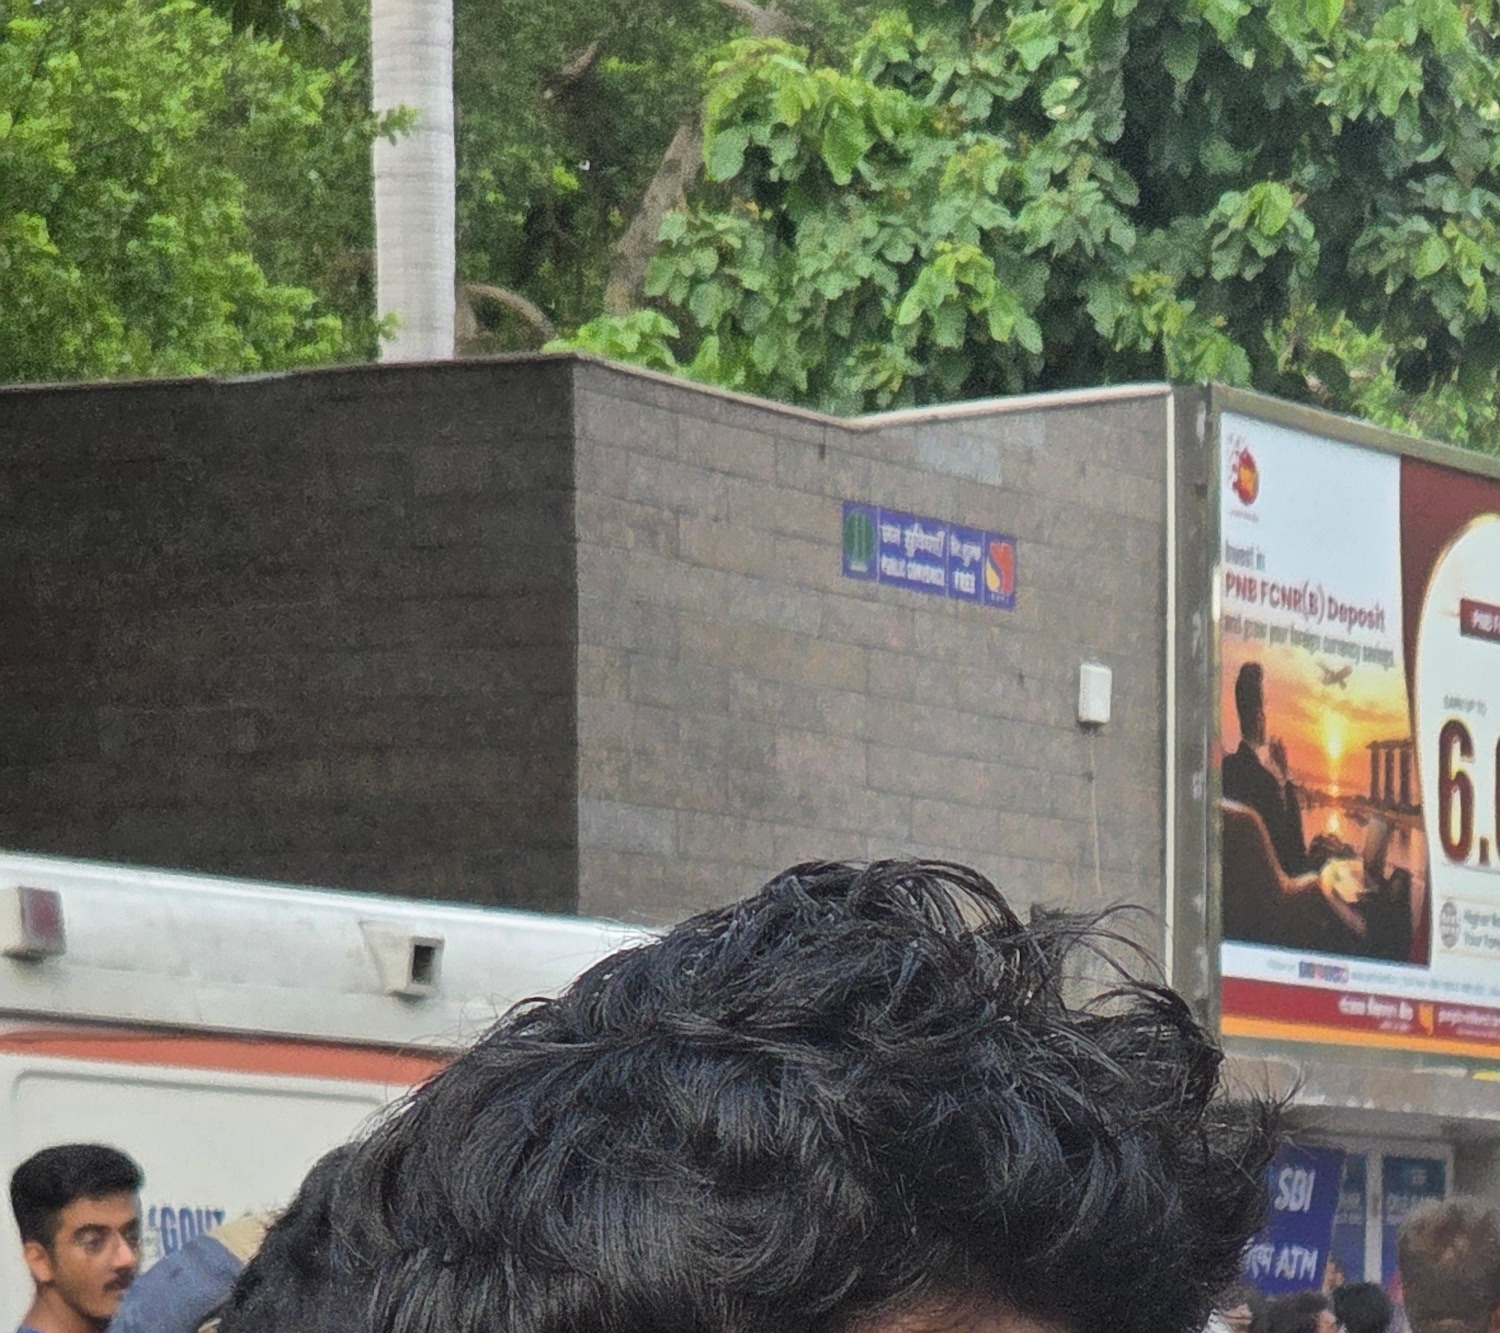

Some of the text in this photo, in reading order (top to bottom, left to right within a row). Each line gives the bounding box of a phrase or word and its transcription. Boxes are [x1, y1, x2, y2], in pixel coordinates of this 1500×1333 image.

[1225, 570, 1258, 604] PNB
[1327, 592, 1386, 634] Deposit
[1274, 1245, 1319, 1283] ATM
